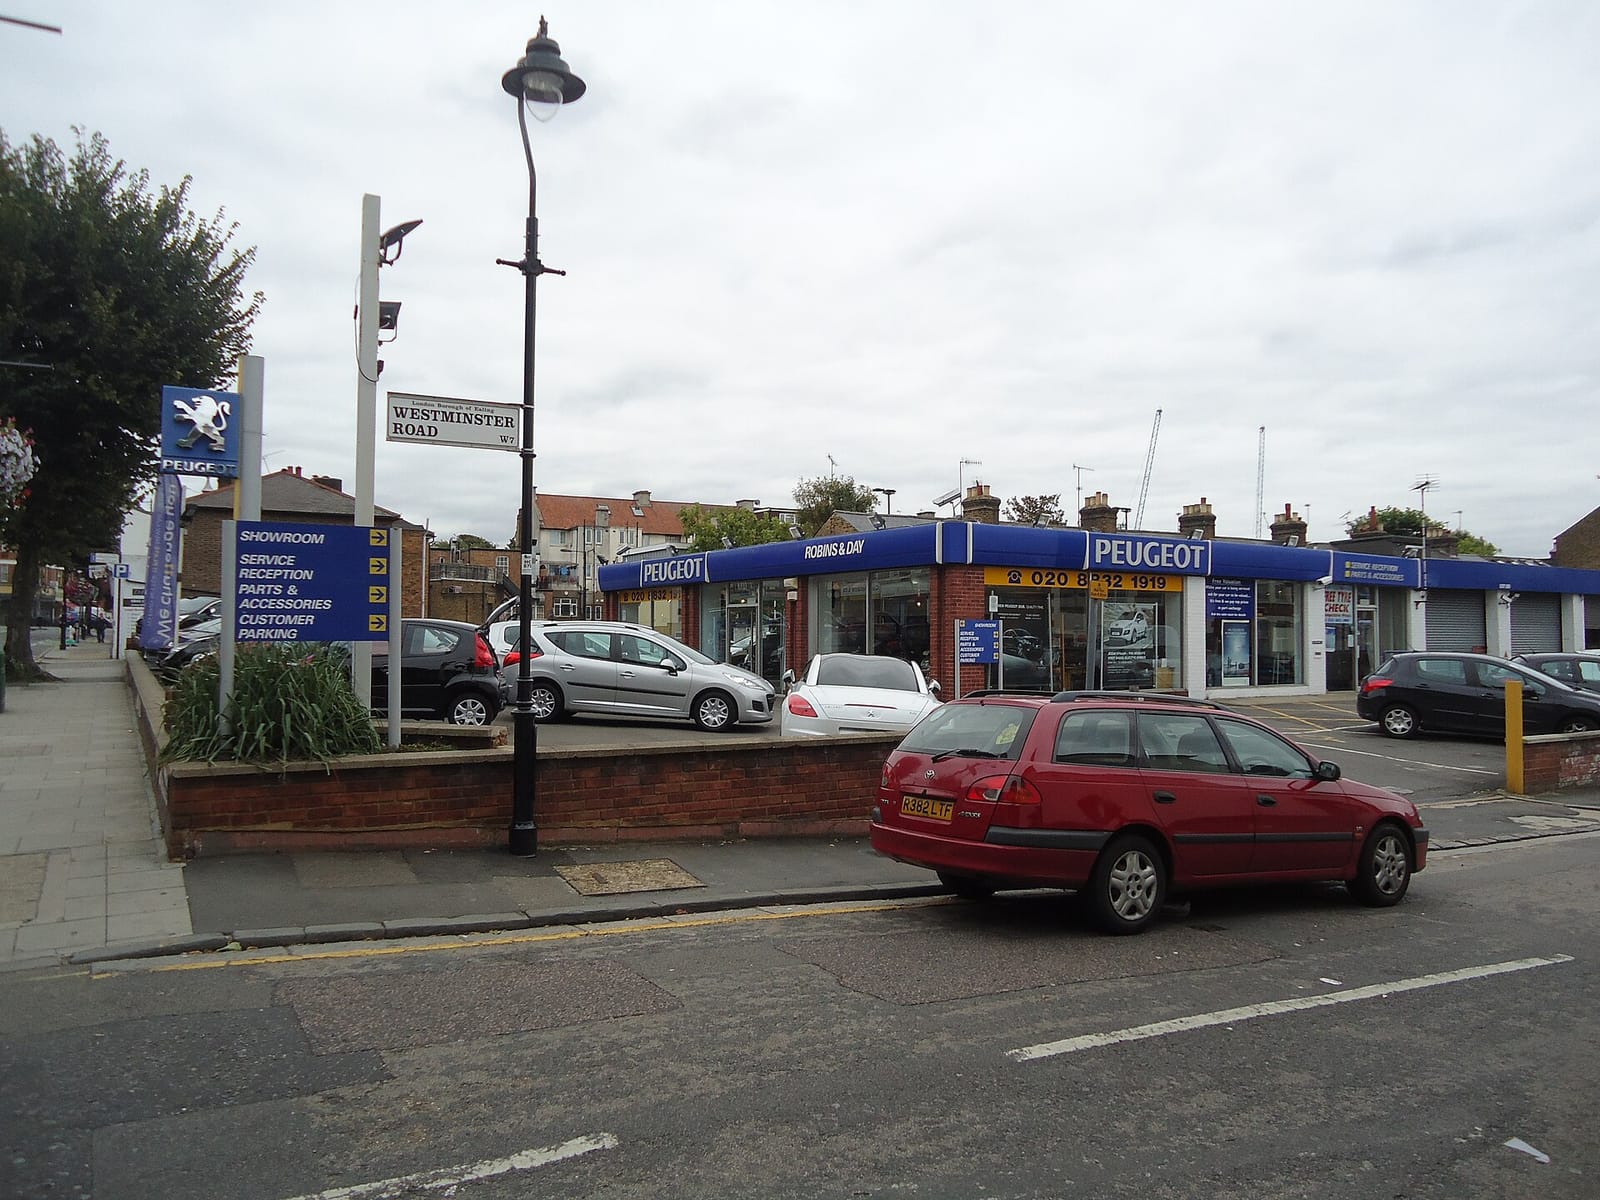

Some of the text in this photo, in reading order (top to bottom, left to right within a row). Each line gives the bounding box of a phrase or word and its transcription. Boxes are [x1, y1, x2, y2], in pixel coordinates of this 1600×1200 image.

[437, 403, 464, 411] Borough
[393, 406, 516, 429] WESTMINSTER
[392, 422, 439, 438] ROAD
[500, 435, 515, 444] W7
[162, 459, 237, 475] PEUGEOT
[239, 530, 325, 544] SHOWROOM
[804, 539, 865, 560] ROBINS & DAY
[1094, 538, 1205, 569] PEUGEOT
[239, 554, 296, 566] SERVICE
[238, 568, 314, 580] RECEPTION
[643, 558, 703, 583] PEUGEOT
[1031, 571, 1069, 586] 020
[1131, 575, 1167, 589] 1919
[238, 584, 298, 596] PARTS &
[631, 591, 645, 601] 020
[238, 598, 332, 610] ACCESSORIES
[239, 614, 315, 625] CUSTOMER
[238, 628, 298, 640] PARKING
[902, 797, 931, 814] R382
[931, 801, 952, 817] LTF
